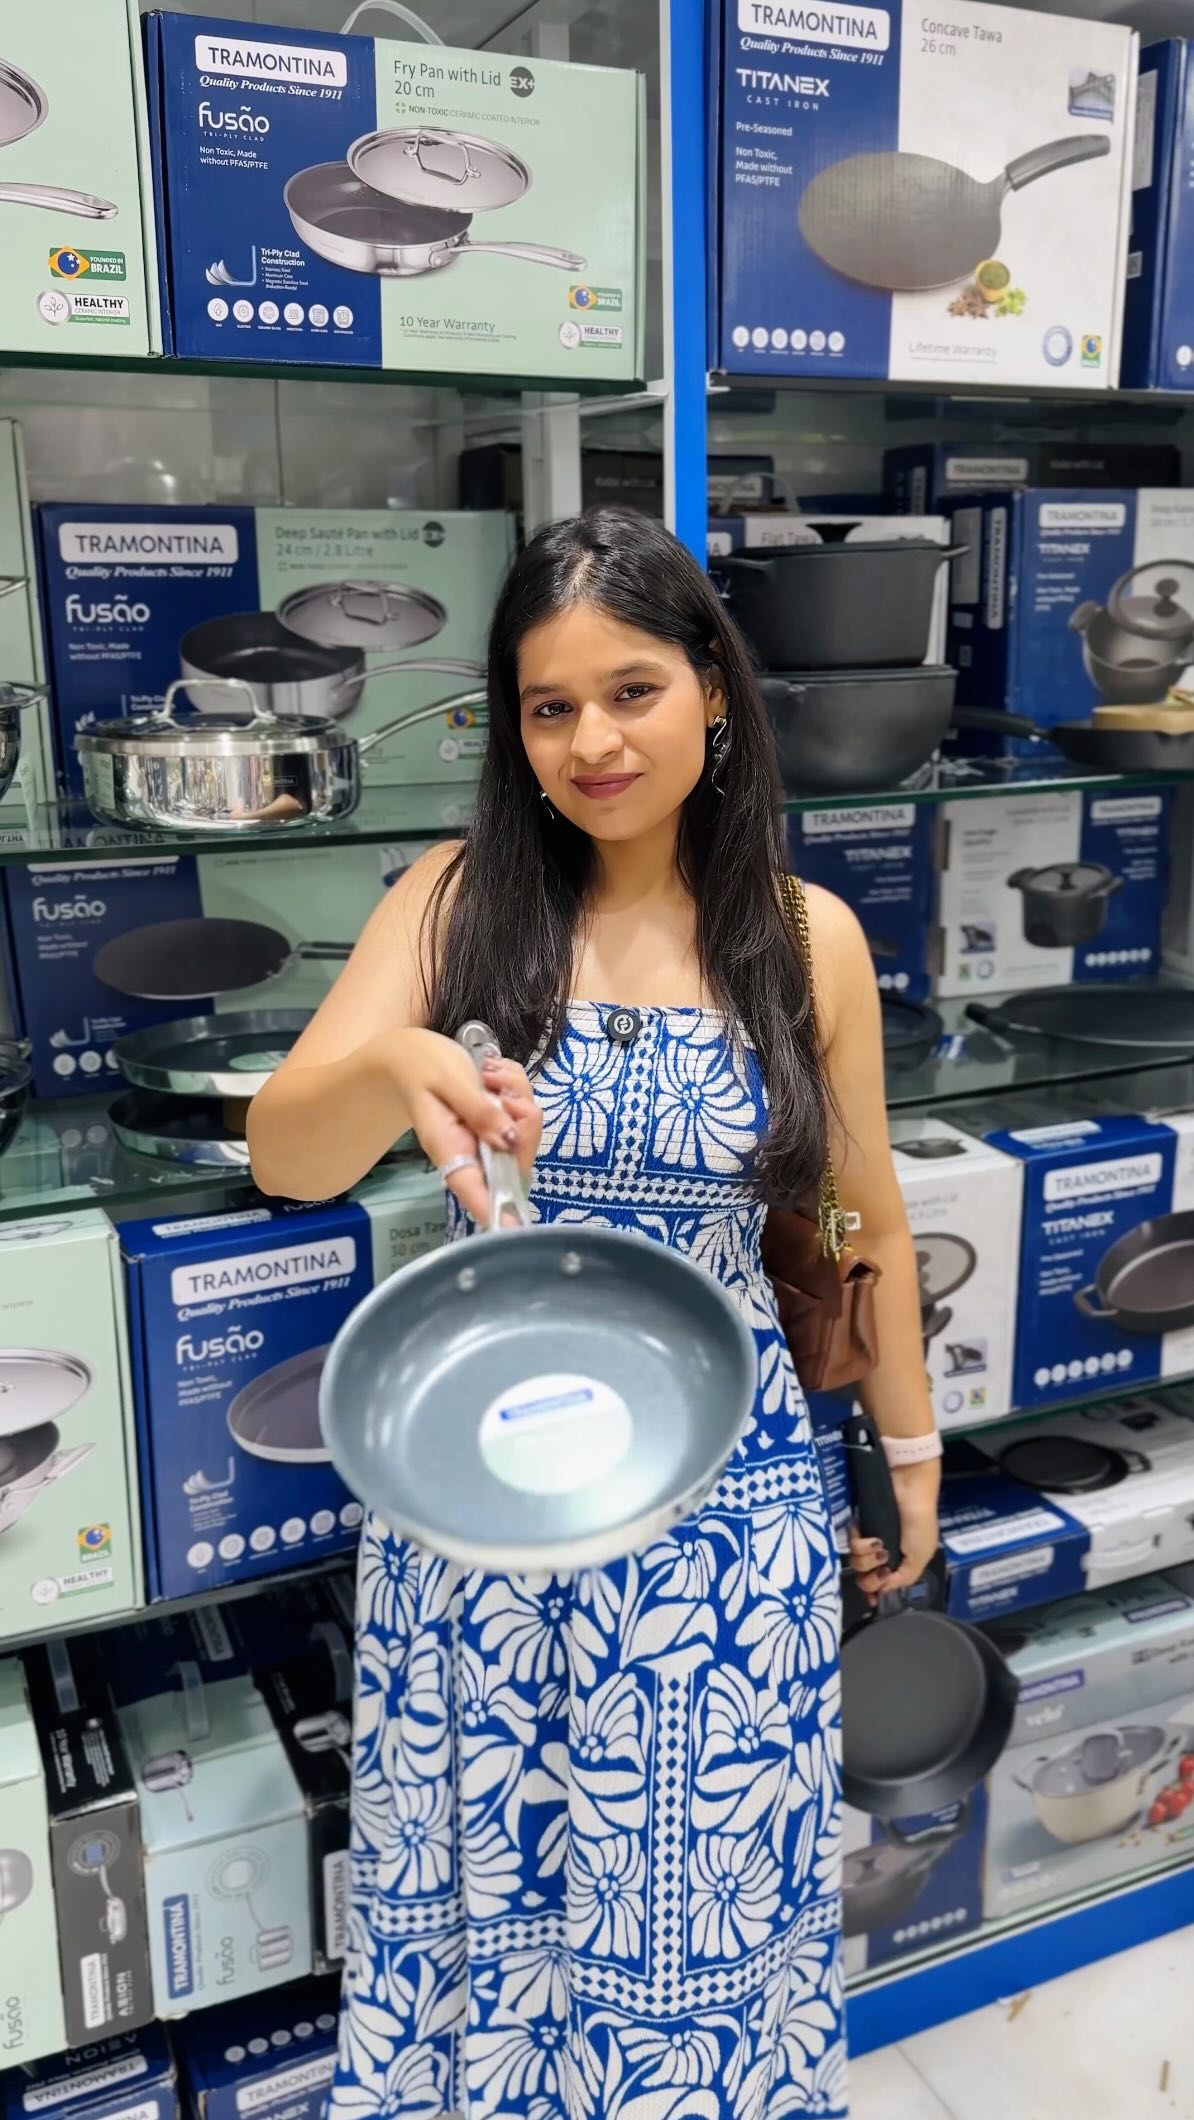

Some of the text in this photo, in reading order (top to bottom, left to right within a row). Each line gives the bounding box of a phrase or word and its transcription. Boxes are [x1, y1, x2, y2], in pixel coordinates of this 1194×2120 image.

[751, 4, 877, 40] TRAMONTINA
[922, 18, 1003, 44] Concave Tawa
[740, 37, 884, 66] Quality Products Since 1911
[921, 38, 957, 56] 26 cm
[208, 47, 335, 77] TRAMONTINA
[394, 60, 501, 86] Fry Pan with Lid
[200, 75, 342, 100] Quality Products Since 1911
[395, 80, 435, 98] 20 cm
[736, 68, 830, 97] TITANEX
[747, 95, 819, 111] CAST IRON
[199, 101, 270, 133] fusão
[450, 109, 481, 120] CERAMIC
[510, 115, 540, 126] INTERIOR
[736, 121, 793, 136] Pre-Seasoned
[200, 146, 257, 158] Non Toxic, Made
[736, 147, 778, 160] Non Toxic,
[200, 157, 269, 169] without PFAS/PTFE
[736, 160, 793, 175] Made without
[736, 173, 781, 187] PFAS/PTFE
[90, 256, 116, 264] FOUNDED
[261, 248, 300, 258] Tri-Ply Clad
[261, 257, 305, 267] Construction
[91, 263, 124, 275] BRAZIL
[75, 297, 123, 309] HEALTHY
[400, 316, 495, 333] 10 Year Warranty
[584, 326, 618, 336] HEALTHY
[275, 526, 307, 541] Deep
[347, 527, 369, 540] Pan
[372, 527, 398, 540] with
[401, 527, 419, 541] Lid
[75, 535, 224, 554] TRAMONTINA
[276, 543, 293, 557] 24
[65, 566, 233, 580] Quality Products Since 1911
[65, 593, 150, 624] fusão
[813, 809, 905, 827] TRAMONTINA
[33, 894, 107, 923] fusão
[1056, 1164, 1151, 1193] TRAMONTINA
[1042, 1211, 1114, 1235] TITANEX
[390, 1226, 420, 1241] Dosa
[188, 1250, 341, 1294] TRAMONTINA
[177, 1276, 350, 1322] Quality Products Since 1911
[176, 1325, 264, 1365] fusão
[63, 1569, 108, 1585] HEALTHY
[170, 1901, 189, 1993] TRAMONTINA
[34, 2062, 136, 2102] TRAMONTINA
[248, 2060, 333, 2102] TRAMONTIN
